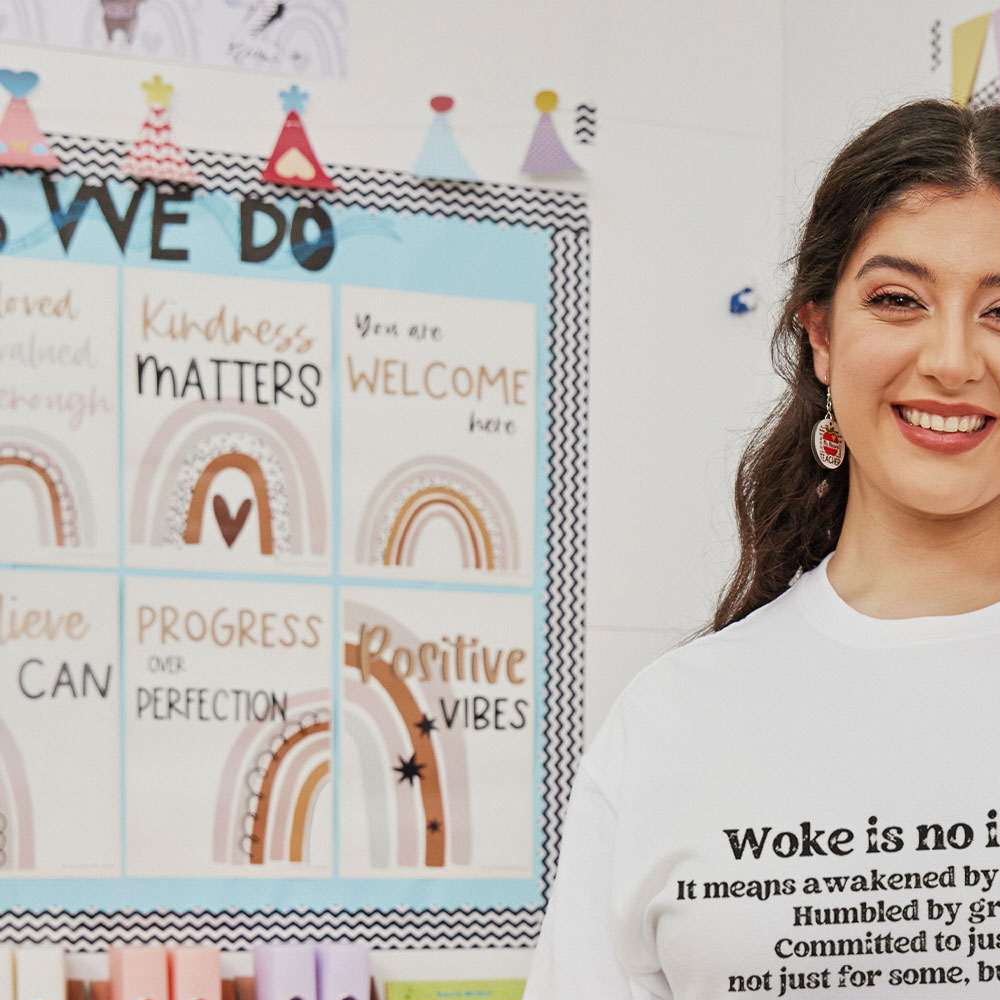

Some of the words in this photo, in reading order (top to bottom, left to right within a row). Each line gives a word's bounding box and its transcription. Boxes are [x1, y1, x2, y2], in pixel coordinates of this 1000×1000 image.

[41, 173, 193, 261] WE
[240, 196, 336, 272] DO
[140, 296, 318, 353] Kindness
[355, 312, 399, 338] You
[409, 323, 443, 342] are
[135, 354, 322, 407] MATTERS
[347, 354, 529, 406] WELCOME
[469, 410, 517, 435] here
[137, 604, 323, 648] PROGRESS
[149, 655, 185, 674] OVER
[358, 622, 527, 685] Positive
[18, 657, 112, 700] CAN
[136, 687, 288, 722] PERFECTION
[439, 695, 529, 730] VIBES
[722, 821, 855, 860] Woke
[866, 815, 905, 854] is
[915, 822, 975, 851] no
[676, 879, 698, 901] It
[703, 877, 797, 901] means
[802, 865, 957, 895] awakened
[963, 864, 1000, 893] by
[792, 899, 920, 927] Humbled
[926, 898, 963, 926] by
[774, 930, 928, 960] Committed
[934, 931, 962, 952] to
[728, 970, 773, 993] not
[778, 966, 832, 998] just
[838, 964, 883, 988] for
[888, 966, 971, 987] some,
